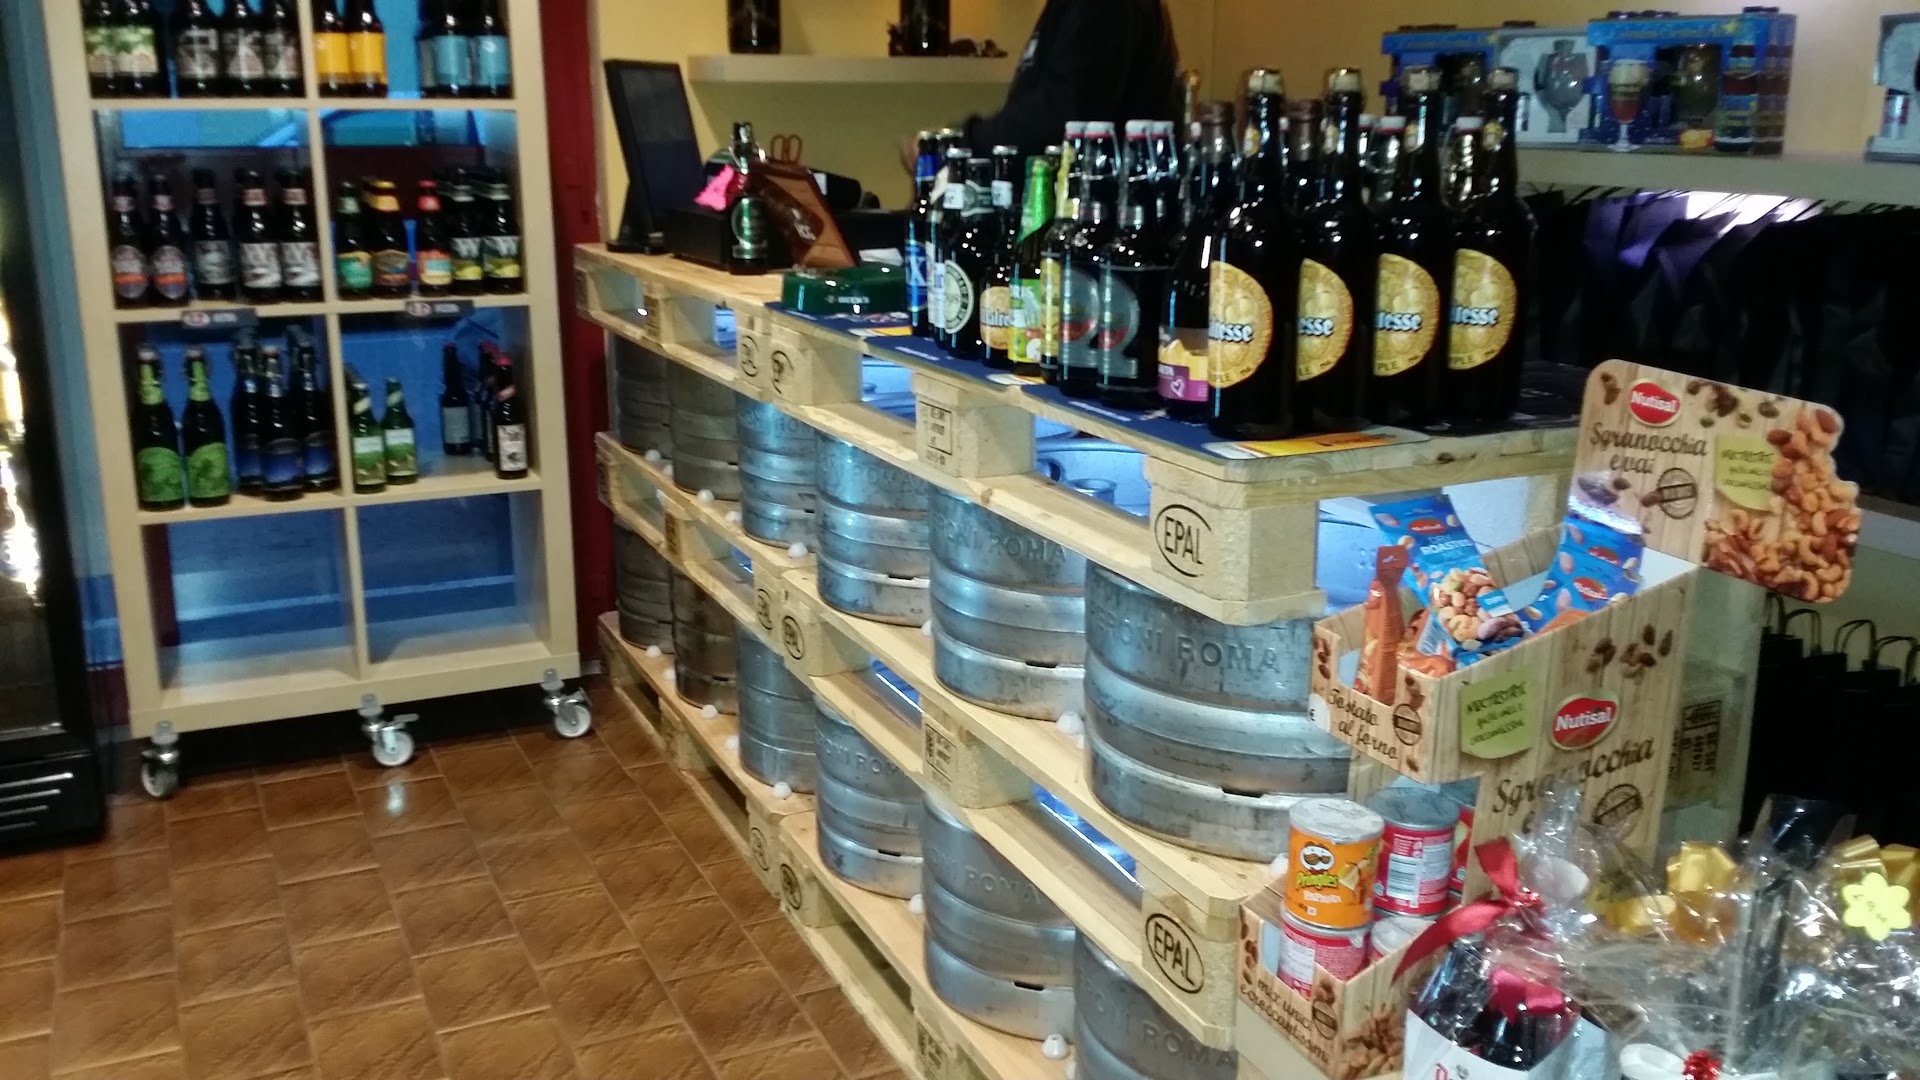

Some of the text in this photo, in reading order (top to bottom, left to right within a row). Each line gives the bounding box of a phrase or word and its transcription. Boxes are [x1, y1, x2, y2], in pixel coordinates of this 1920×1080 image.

[1631, 388, 1677, 413] Nutisal
[1589, 421, 1708, 457] Sgranocchia
[1163, 515, 1206, 566] EPAL
[1177, 632, 1281, 674] ROMA
[1328, 688, 1379, 727] Tostato
[1554, 706, 1612, 732] Nutisal
[1338, 719, 1398, 760] al forno
[1154, 920, 1197, 987] EPAL
